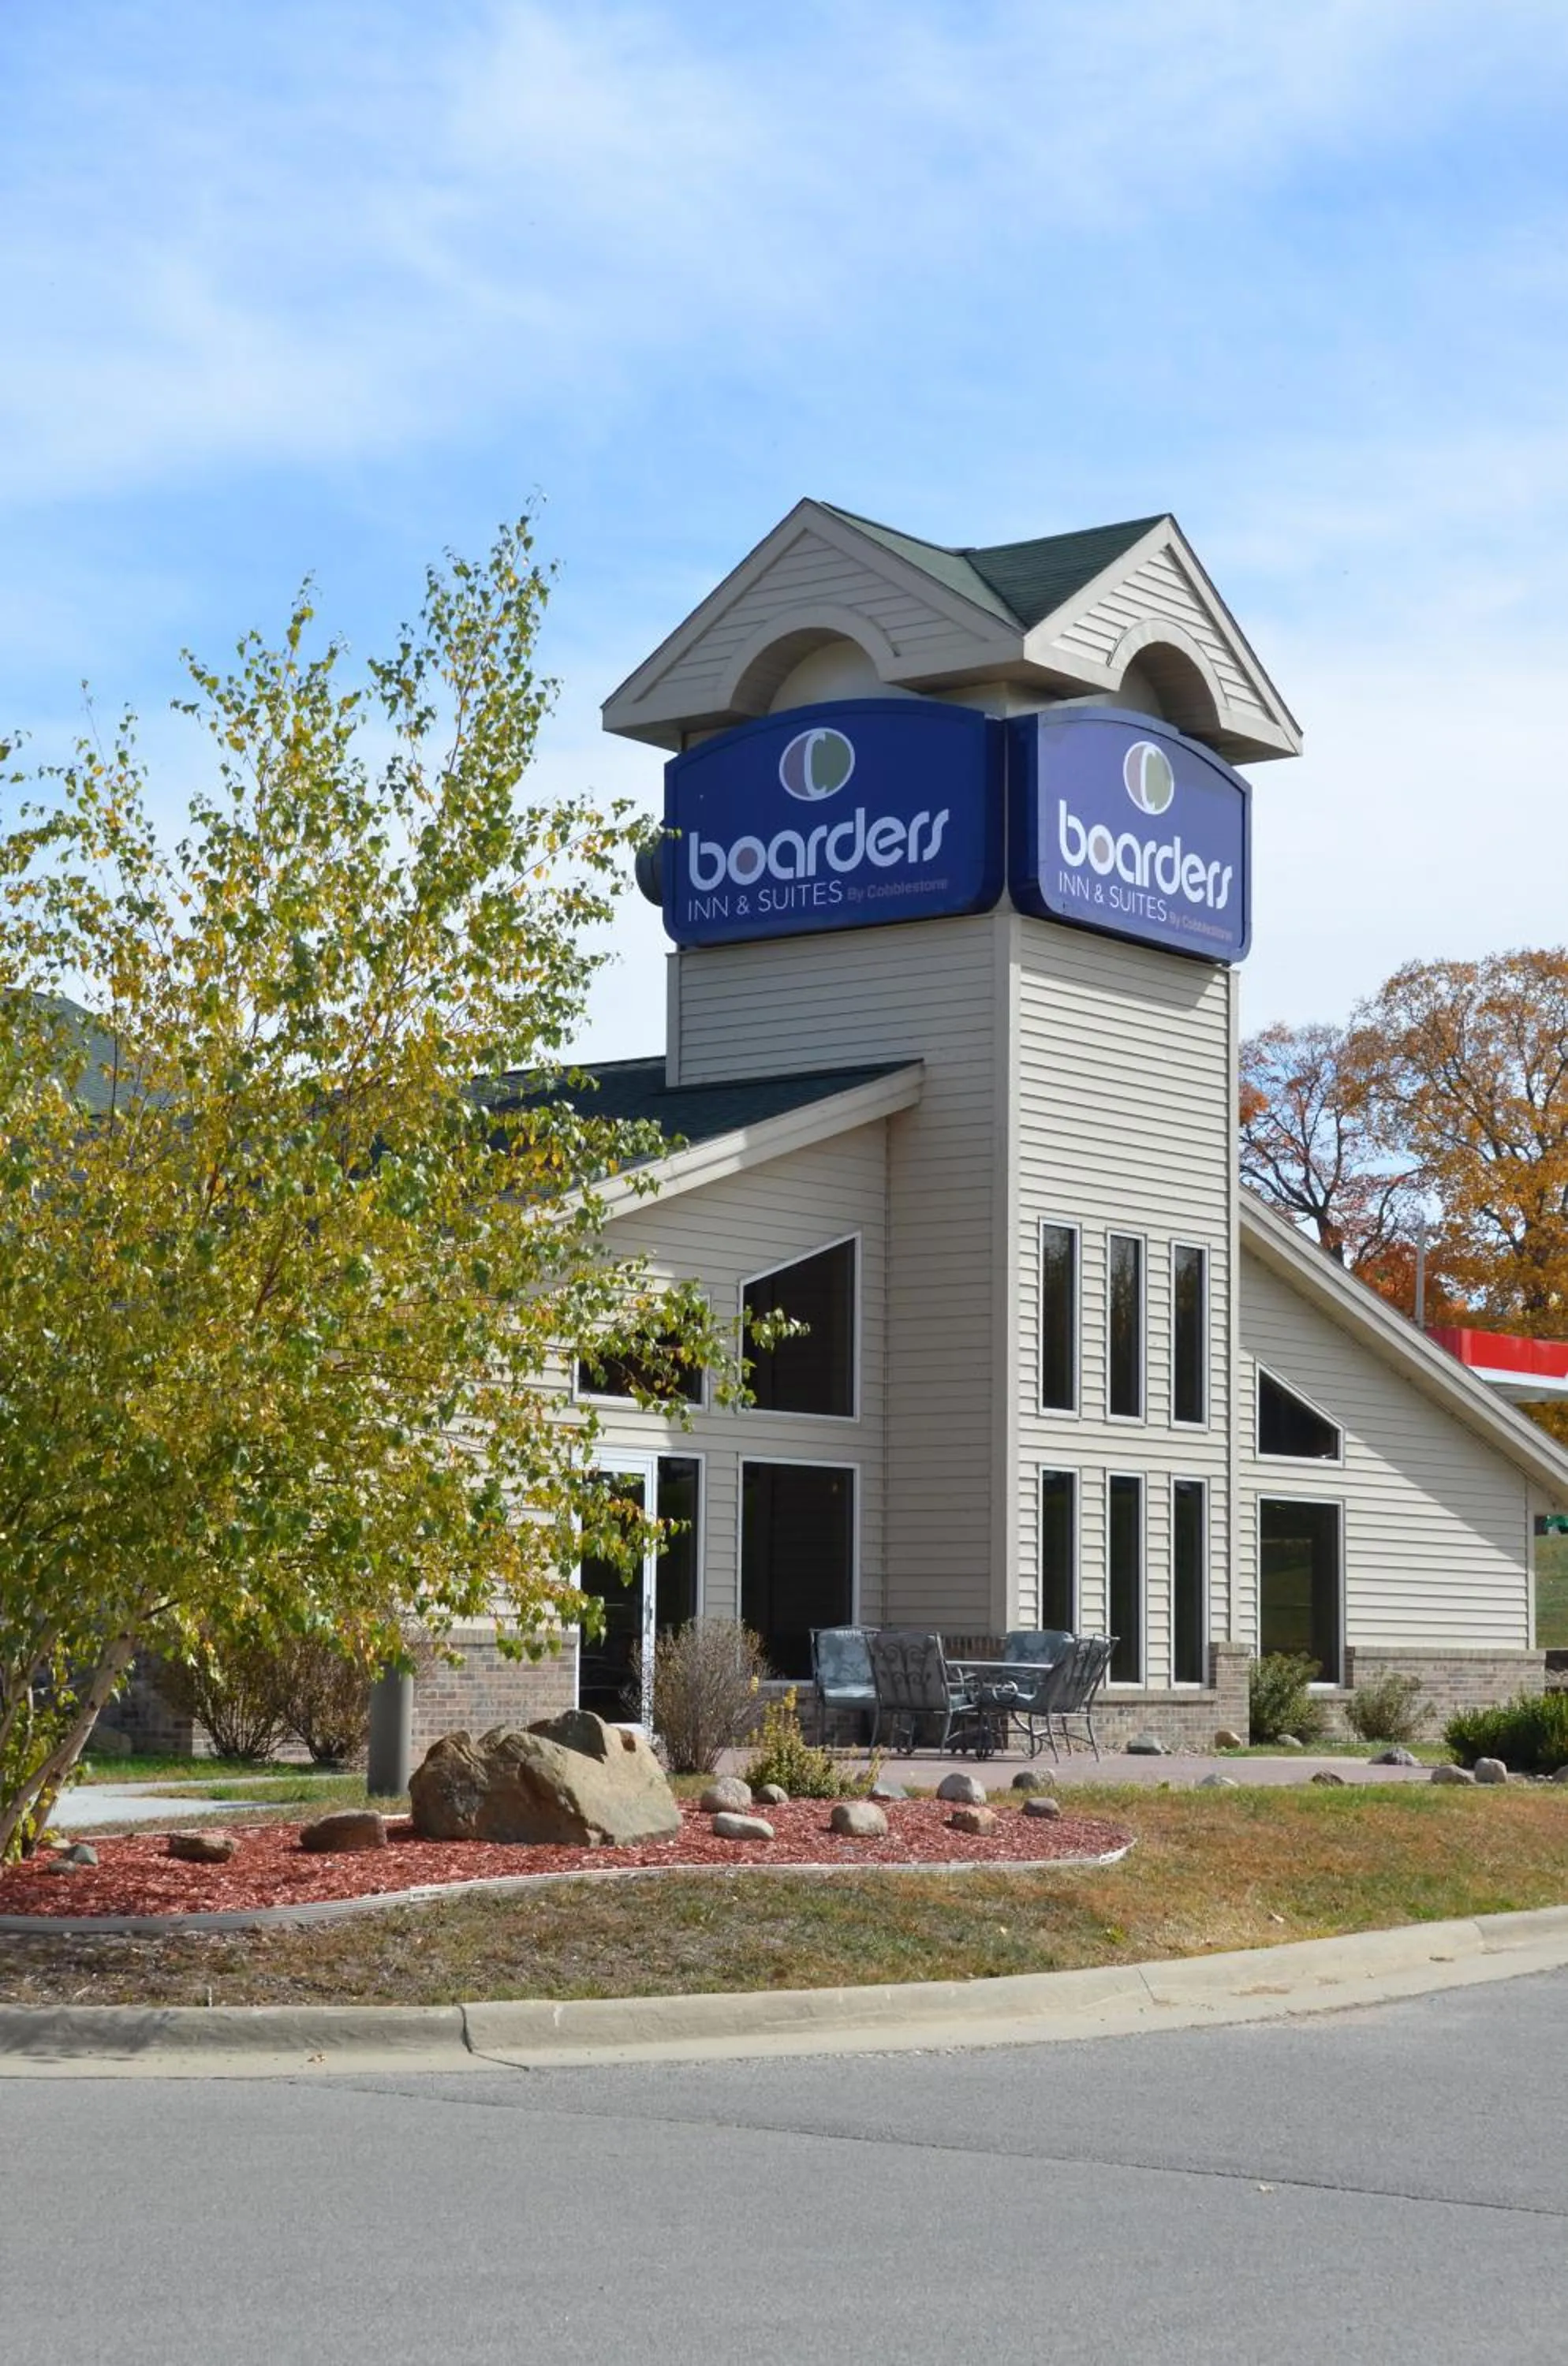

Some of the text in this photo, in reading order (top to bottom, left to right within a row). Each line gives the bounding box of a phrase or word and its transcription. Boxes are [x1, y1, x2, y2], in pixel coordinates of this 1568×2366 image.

[689, 808, 950, 891] boarders
[1058, 799, 1233, 909] boarders
[688, 896, 729, 922] INN
[736, 894, 750, 916] &
[757, 879, 844, 912] SUITES
[847, 886, 865, 903] By
[1058, 871, 1089, 900] INN
[1094, 884, 1105, 904] &
[1109, 886, 1167, 923] SUITES
